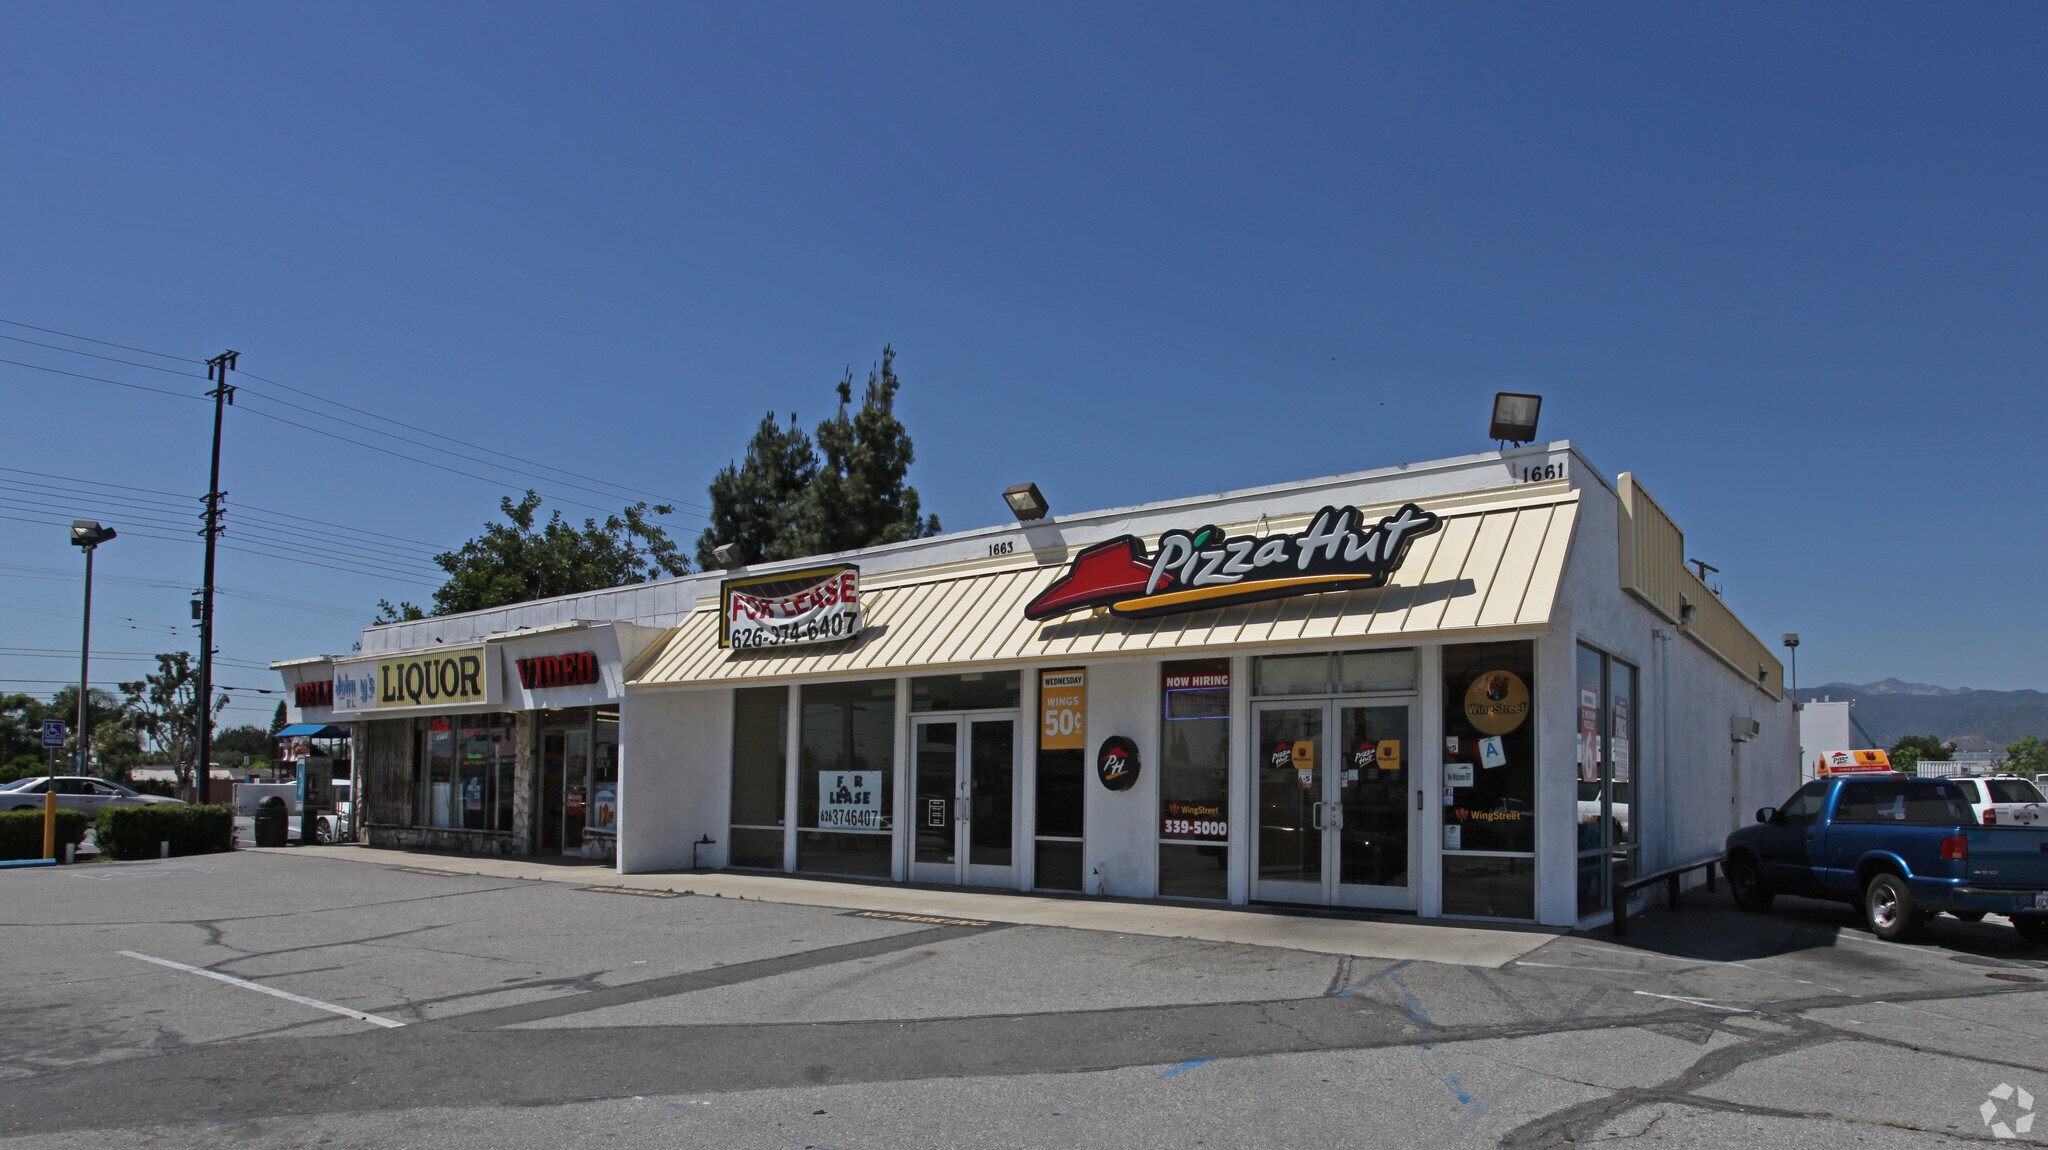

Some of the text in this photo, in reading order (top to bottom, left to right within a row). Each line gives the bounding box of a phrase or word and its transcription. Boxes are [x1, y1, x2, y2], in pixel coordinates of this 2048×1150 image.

[1523, 462, 1564, 484] 1661
[988, 540, 1014, 557] 1663
[1146, 508, 1430, 595] Pizza Hut
[732, 573, 857, 622] FOR LEASE
[731, 611, 858, 649] 626-374-6407
[515, 650, 600, 690] VIDEO
[382, 655, 482, 705] LIQUOR
[1044, 675, 1083, 687] WEDNESDAY
[1166, 675, 1229, 688] NOW HIRING
[1047, 696, 1080, 707] WINGS
[1467, 702, 1527, 716] WingStreet
[1272, 750, 1291, 763] Pizza
[1355, 749, 1376, 763] Pizza
[1486, 742, 1499, 758] A
[1103, 754, 1125, 775] PH
[1276, 755, 1290, 765] Hut
[1359, 755, 1374, 764] Hut
[829, 791, 871, 805] LEASE
[1181, 805, 1219, 815] WingStreet
[1470, 811, 1521, 822] WingStreet
[1164, 820, 1228, 835] 339-5000
